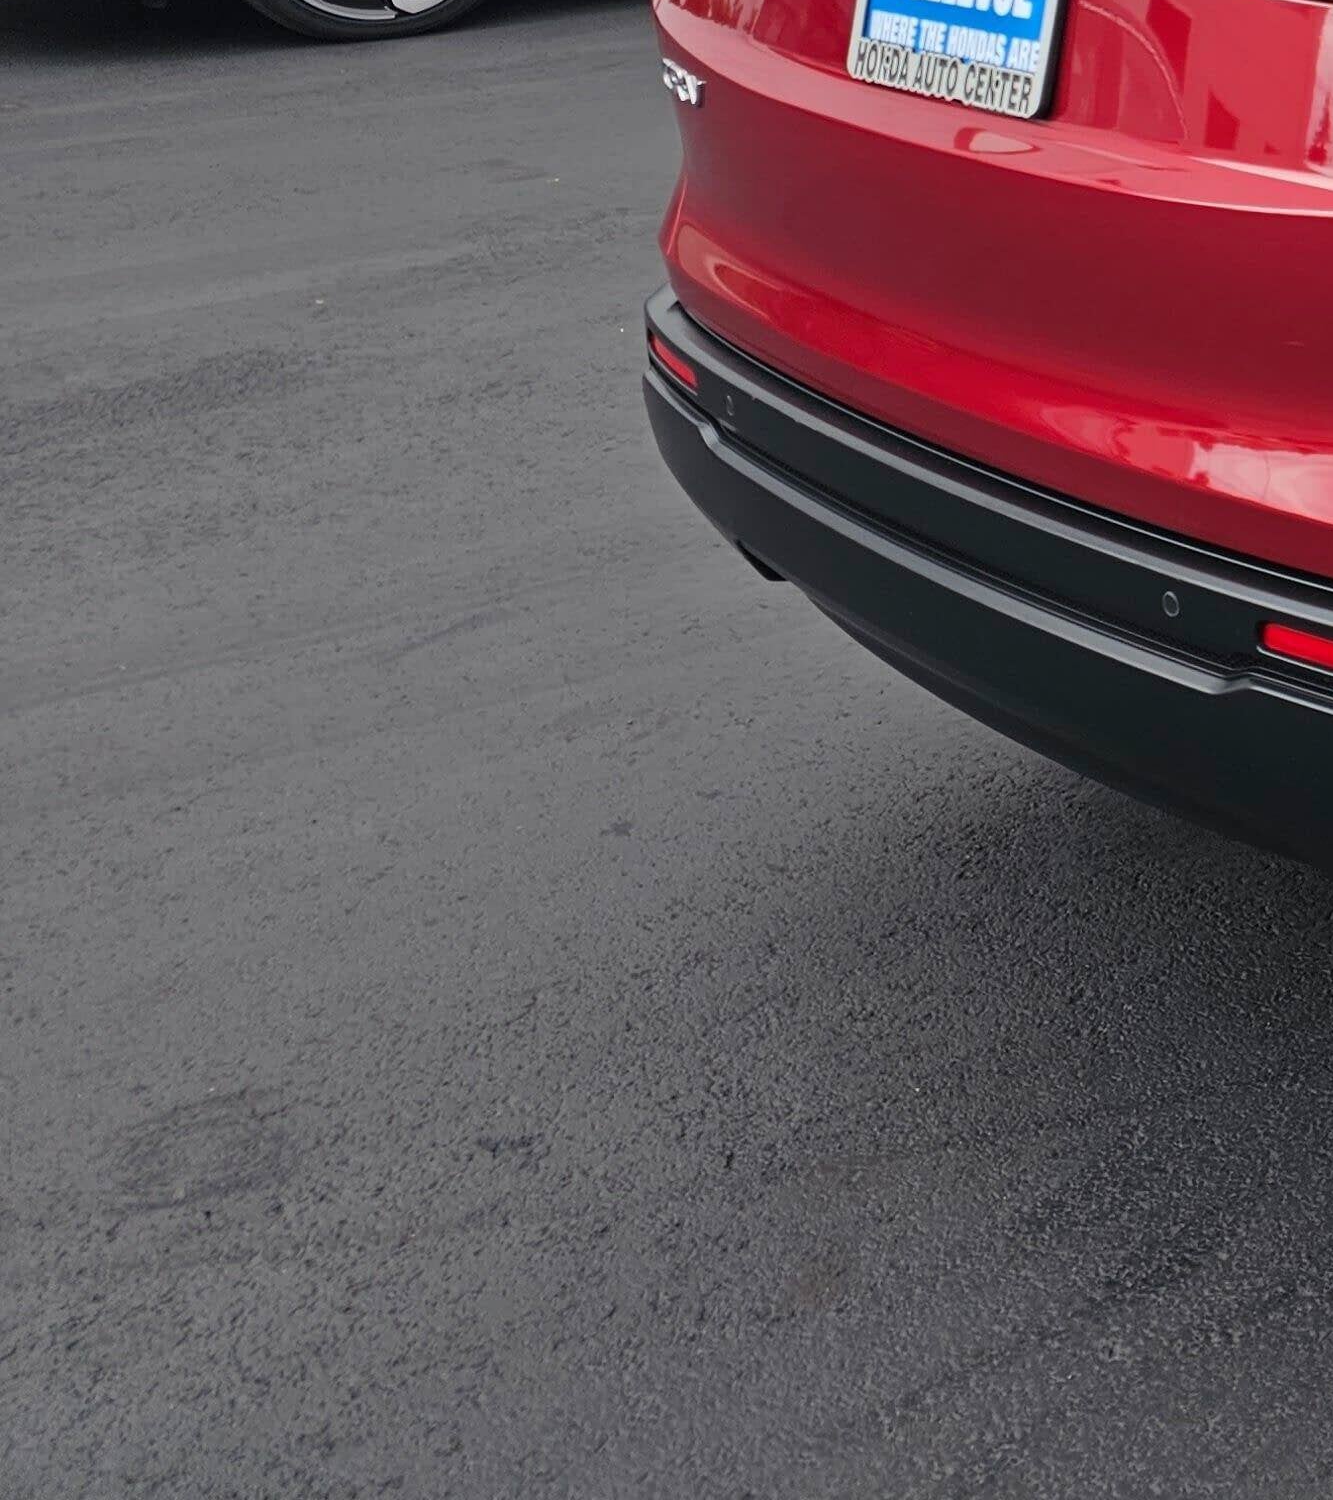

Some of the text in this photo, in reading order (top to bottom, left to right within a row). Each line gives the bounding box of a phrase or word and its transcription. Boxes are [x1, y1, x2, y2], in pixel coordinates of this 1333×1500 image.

[868, 9, 1040, 73] WHERE THE HONDAS ARE
[853, 41, 1033, 114] HONDA AUTO CENTER
